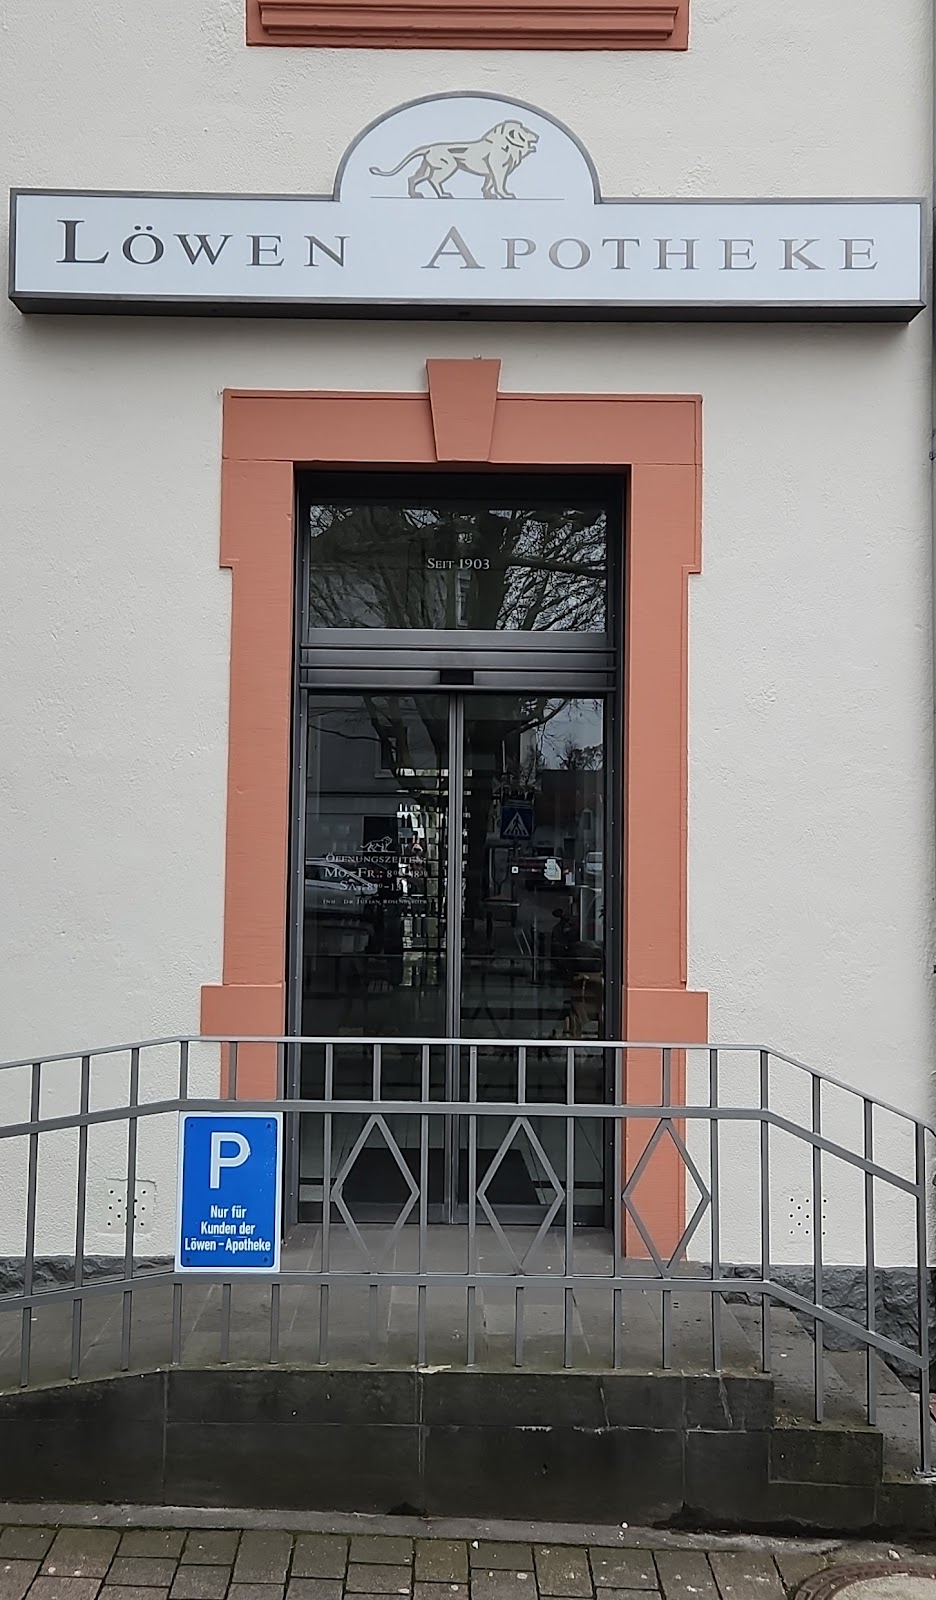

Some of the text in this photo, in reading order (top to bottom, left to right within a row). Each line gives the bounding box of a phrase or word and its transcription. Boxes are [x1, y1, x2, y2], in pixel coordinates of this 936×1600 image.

[56, 219, 878, 270] LÖWEN APOTHEKE
[427, 557, 490, 569] SEIT 1903
[209, 1131, 251, 1190] P
[210, 1205, 247, 1219] Nur für
[200, 1222, 256, 1235] Kunden der
